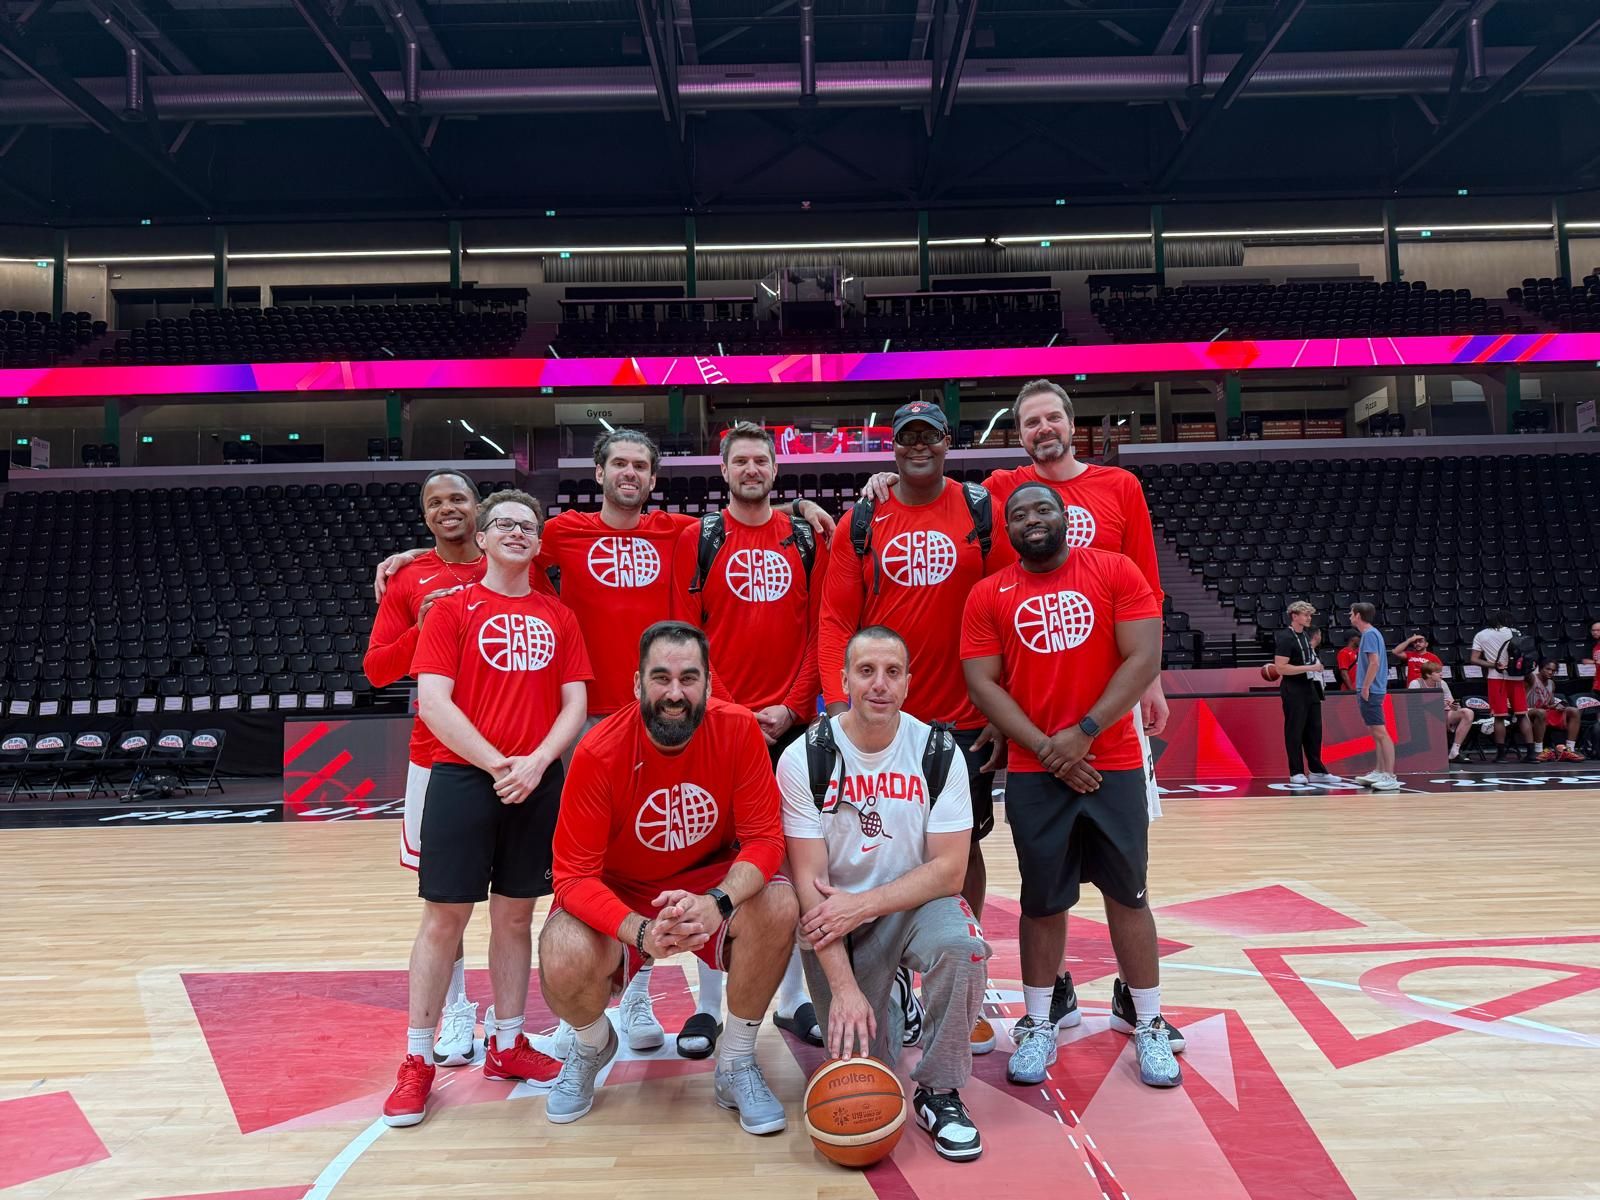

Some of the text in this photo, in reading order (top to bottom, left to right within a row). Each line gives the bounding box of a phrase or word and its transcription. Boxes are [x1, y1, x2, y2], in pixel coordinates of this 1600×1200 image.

[586, 409, 613, 419] Gyros
[617, 536, 634, 588] CAN
[751, 548, 766, 602] CAN
[912, 530, 927, 586] CAN
[510, 613, 527, 671] CAN
[1044, 593, 1065, 652] CAN
[98, 808, 275, 821] FIBA
[669, 784, 686, 851] CAN
[828, 1072, 875, 1089] molten
